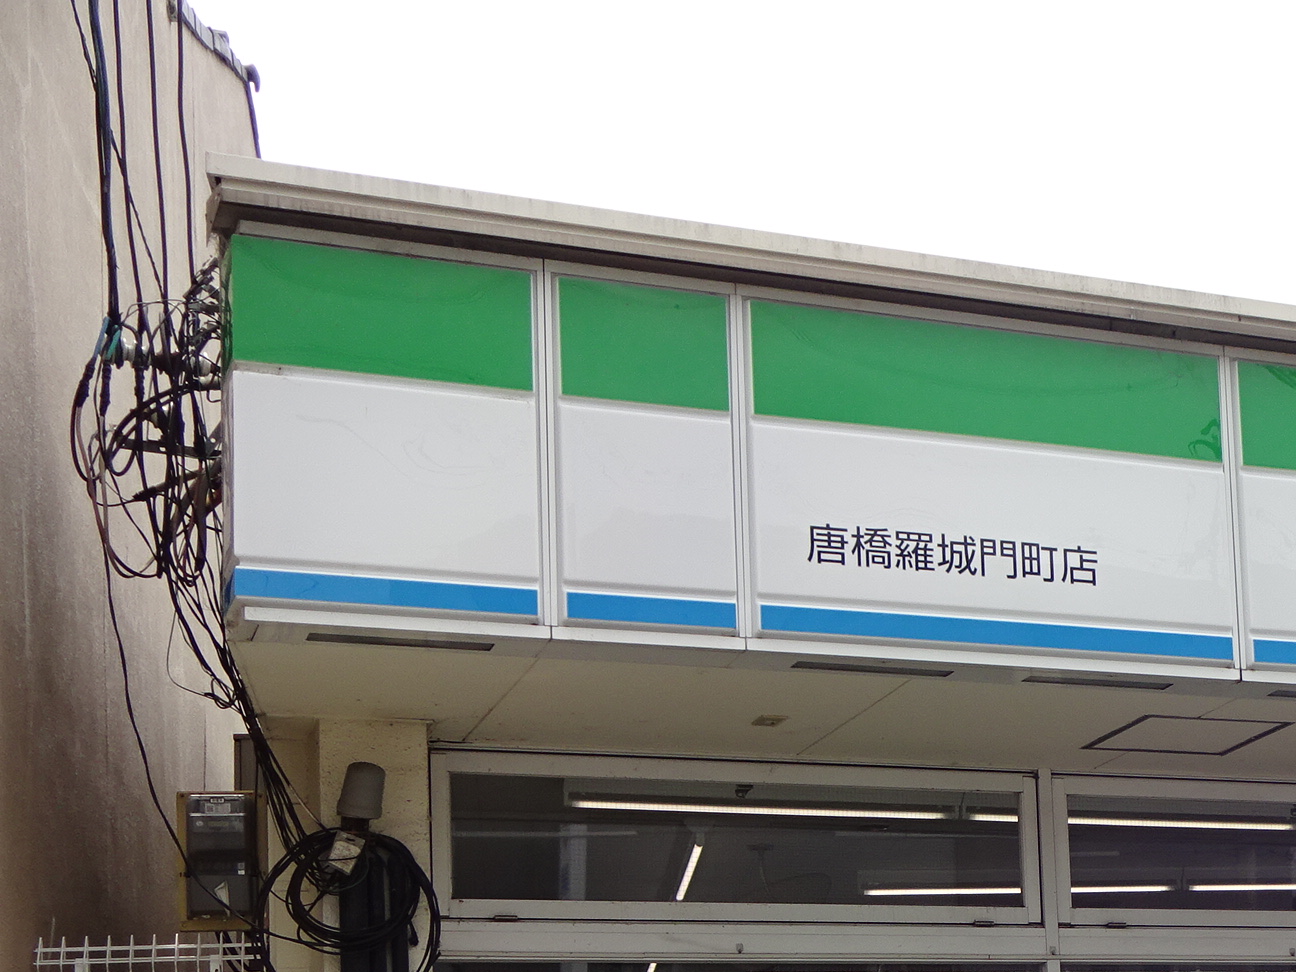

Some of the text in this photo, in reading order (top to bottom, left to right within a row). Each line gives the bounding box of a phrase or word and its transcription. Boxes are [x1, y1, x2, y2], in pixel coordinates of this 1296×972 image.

[807, 523, 1098, 586] 唐橋羅城門町店
